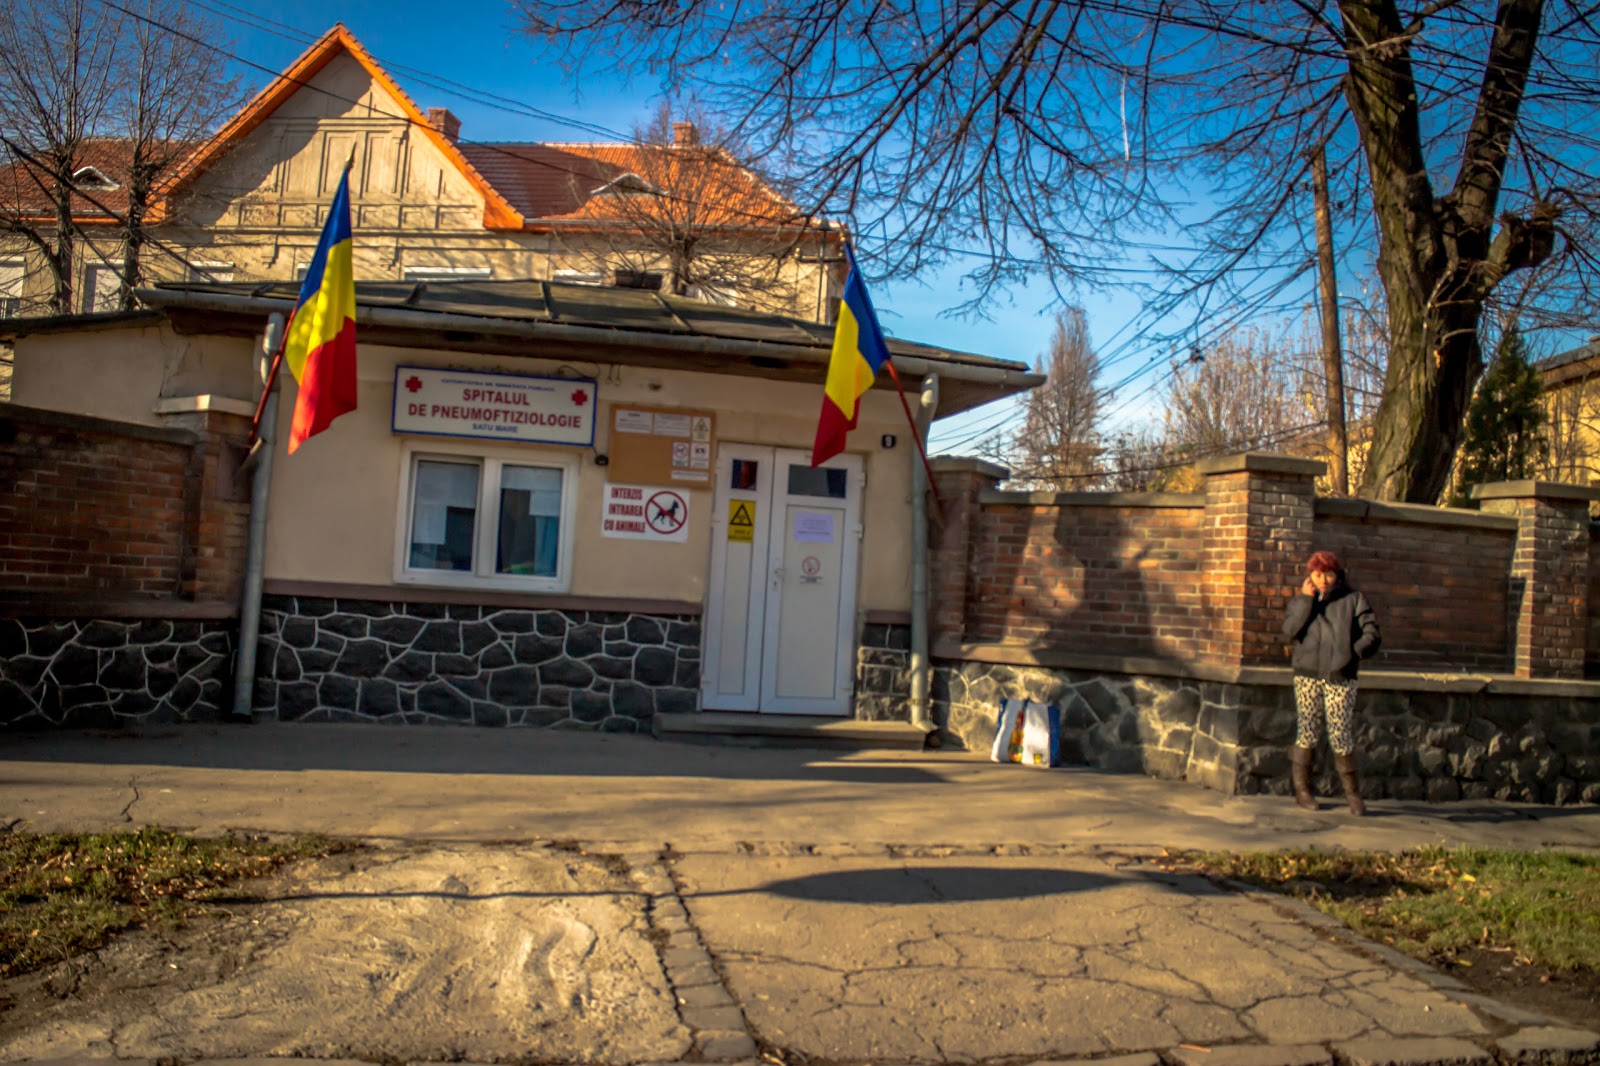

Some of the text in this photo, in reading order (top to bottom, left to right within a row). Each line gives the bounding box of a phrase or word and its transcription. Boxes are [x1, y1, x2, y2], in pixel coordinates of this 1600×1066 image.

[463, 388, 531, 406] SPITALUL
[408, 403, 582, 428] DE PNEUMOFTIZIOLOGIE
[472, 423, 518, 433] SATU MARE
[612, 487, 643, 499] INTERZIS
[609, 504, 643, 516] INTRAREA
[604, 518, 646, 533] CU ANIMALE
